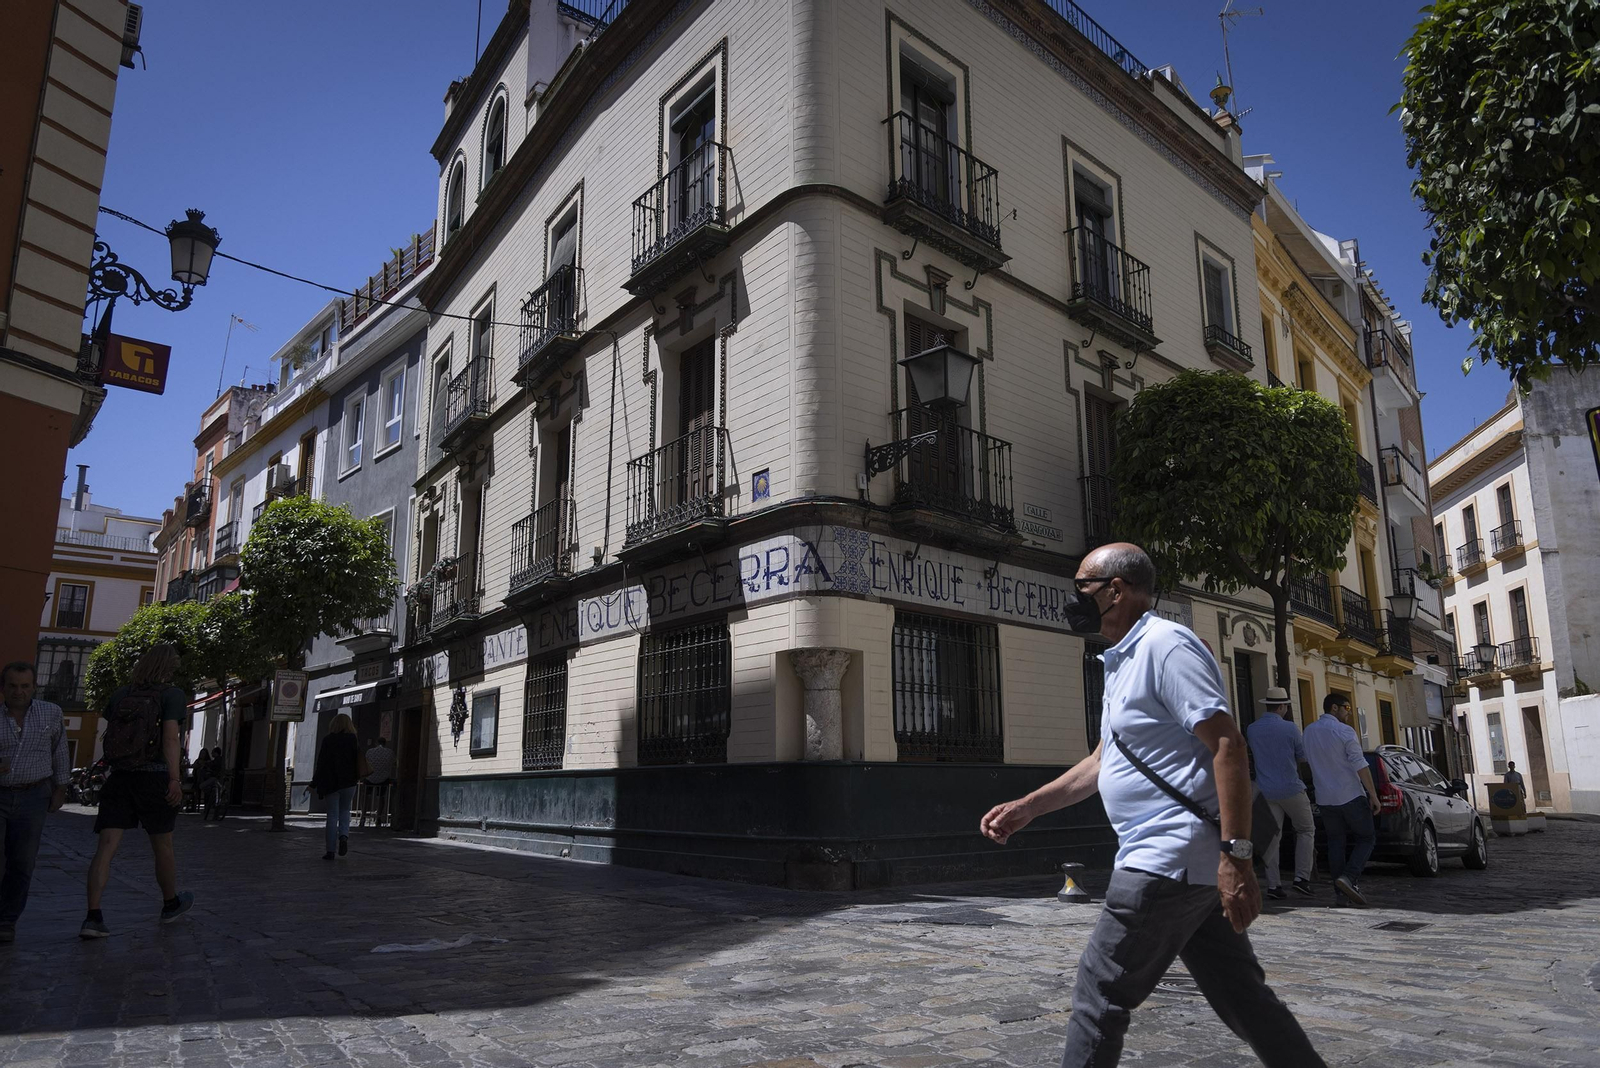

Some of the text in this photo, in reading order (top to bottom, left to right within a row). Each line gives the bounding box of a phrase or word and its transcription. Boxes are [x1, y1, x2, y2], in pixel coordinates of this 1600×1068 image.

[108, 369, 160, 386] TABACOS
[1026, 505, 1049, 519] CALLE
[1020, 519, 1057, 539] ZARAGOZA
[648, 540, 833, 619] BECERRA
[360, 665, 380, 678] TACOS
